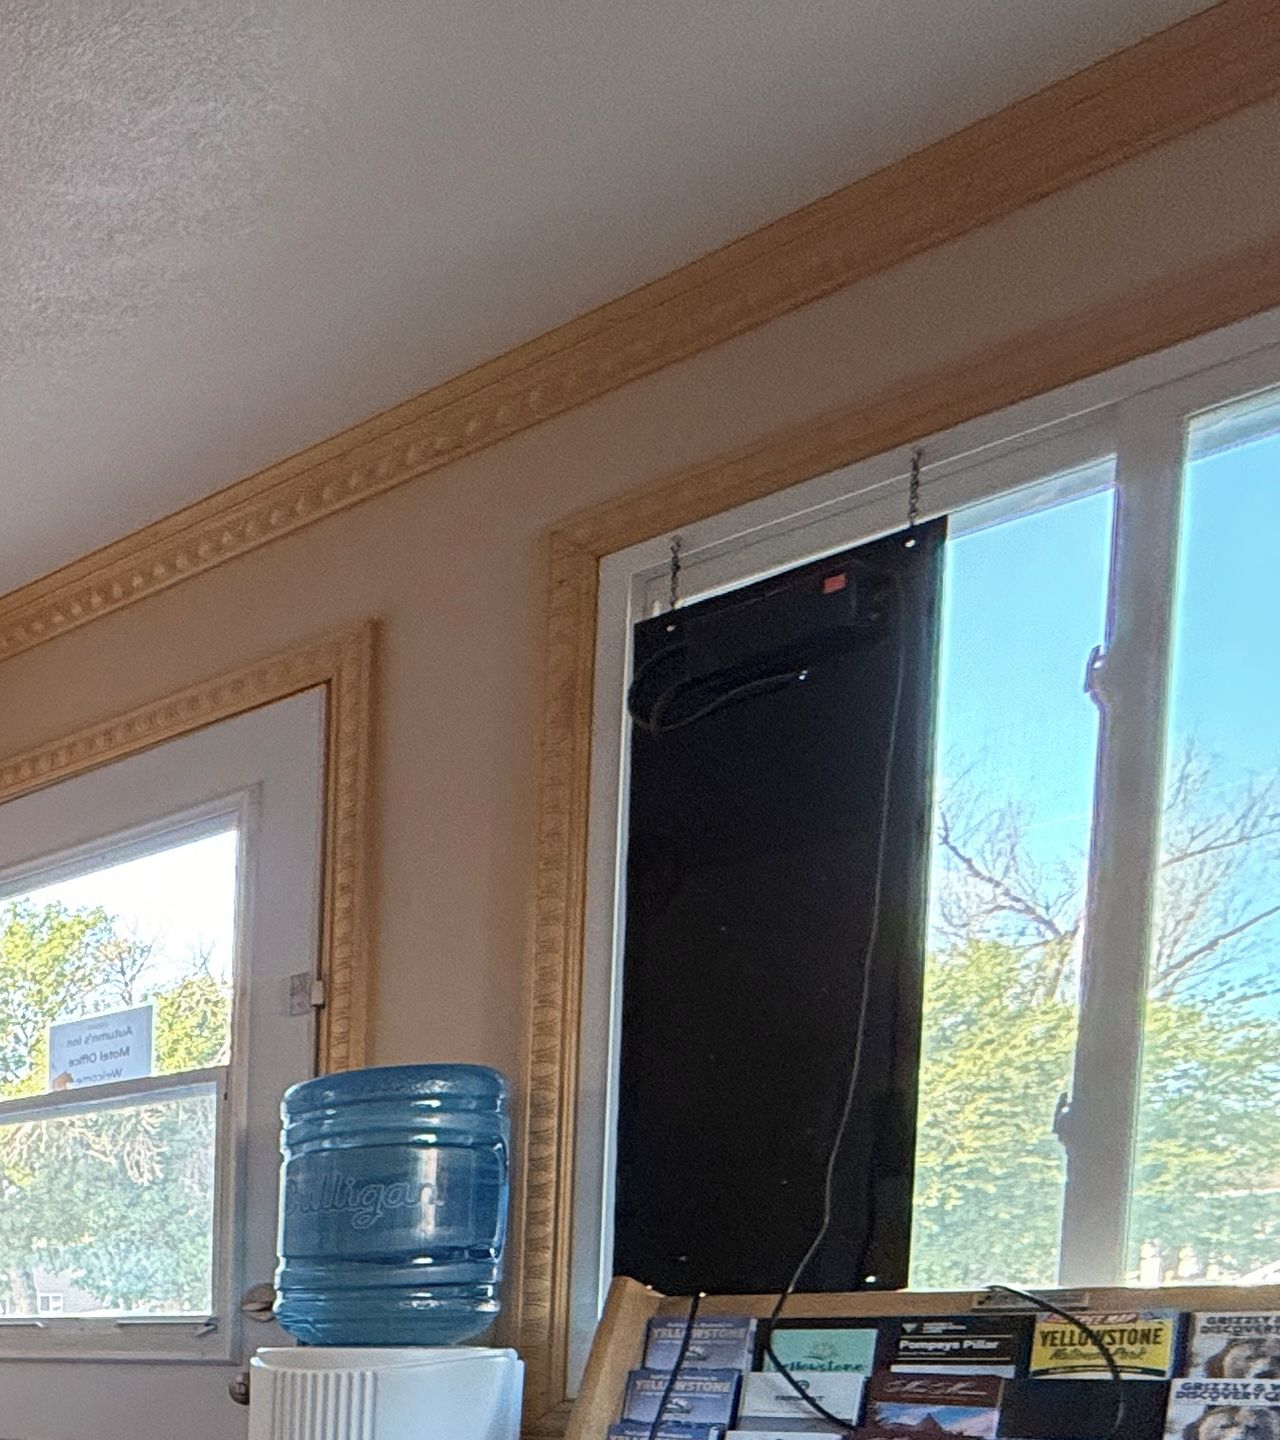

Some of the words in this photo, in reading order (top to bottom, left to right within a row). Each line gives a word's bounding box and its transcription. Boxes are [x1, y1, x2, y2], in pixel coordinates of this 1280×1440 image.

[652, 1327, 746, 1340] YELLWSTONE
[899, 1340, 961, 1351] Pompeys
[962, 1339, 1000, 1350] Pillar
[635, 1380, 731, 1393] YELLWSTONE
